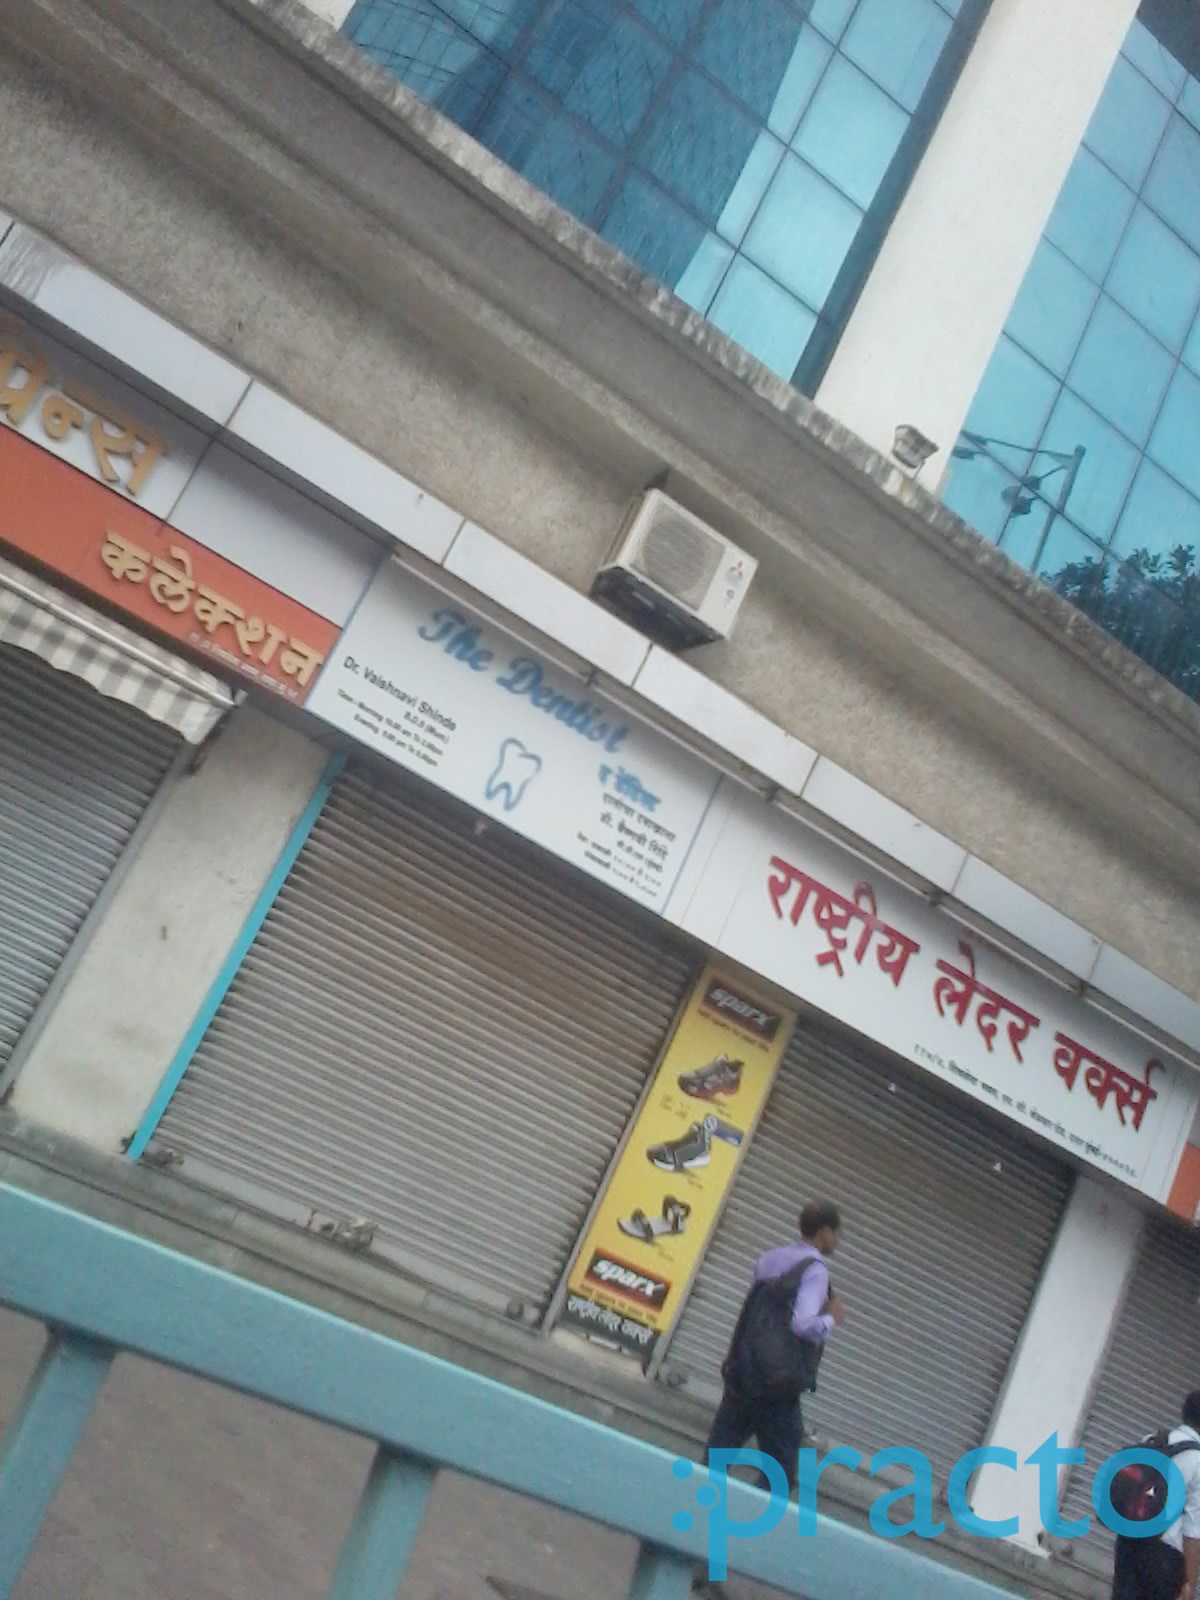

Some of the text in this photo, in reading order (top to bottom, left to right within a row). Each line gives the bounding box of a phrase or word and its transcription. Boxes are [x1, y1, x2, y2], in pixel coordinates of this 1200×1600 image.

[343, 655, 457, 731] Dr. Vaishnavi Shinde
[417, 608, 629, 753] The Dentist
[767, 855, 920, 986] राष्ट्रीय
[933, 940, 1041, 1063] लेदर
[707, 986, 774, 1028] sparx
[593, 1259, 665, 1297] sparx
